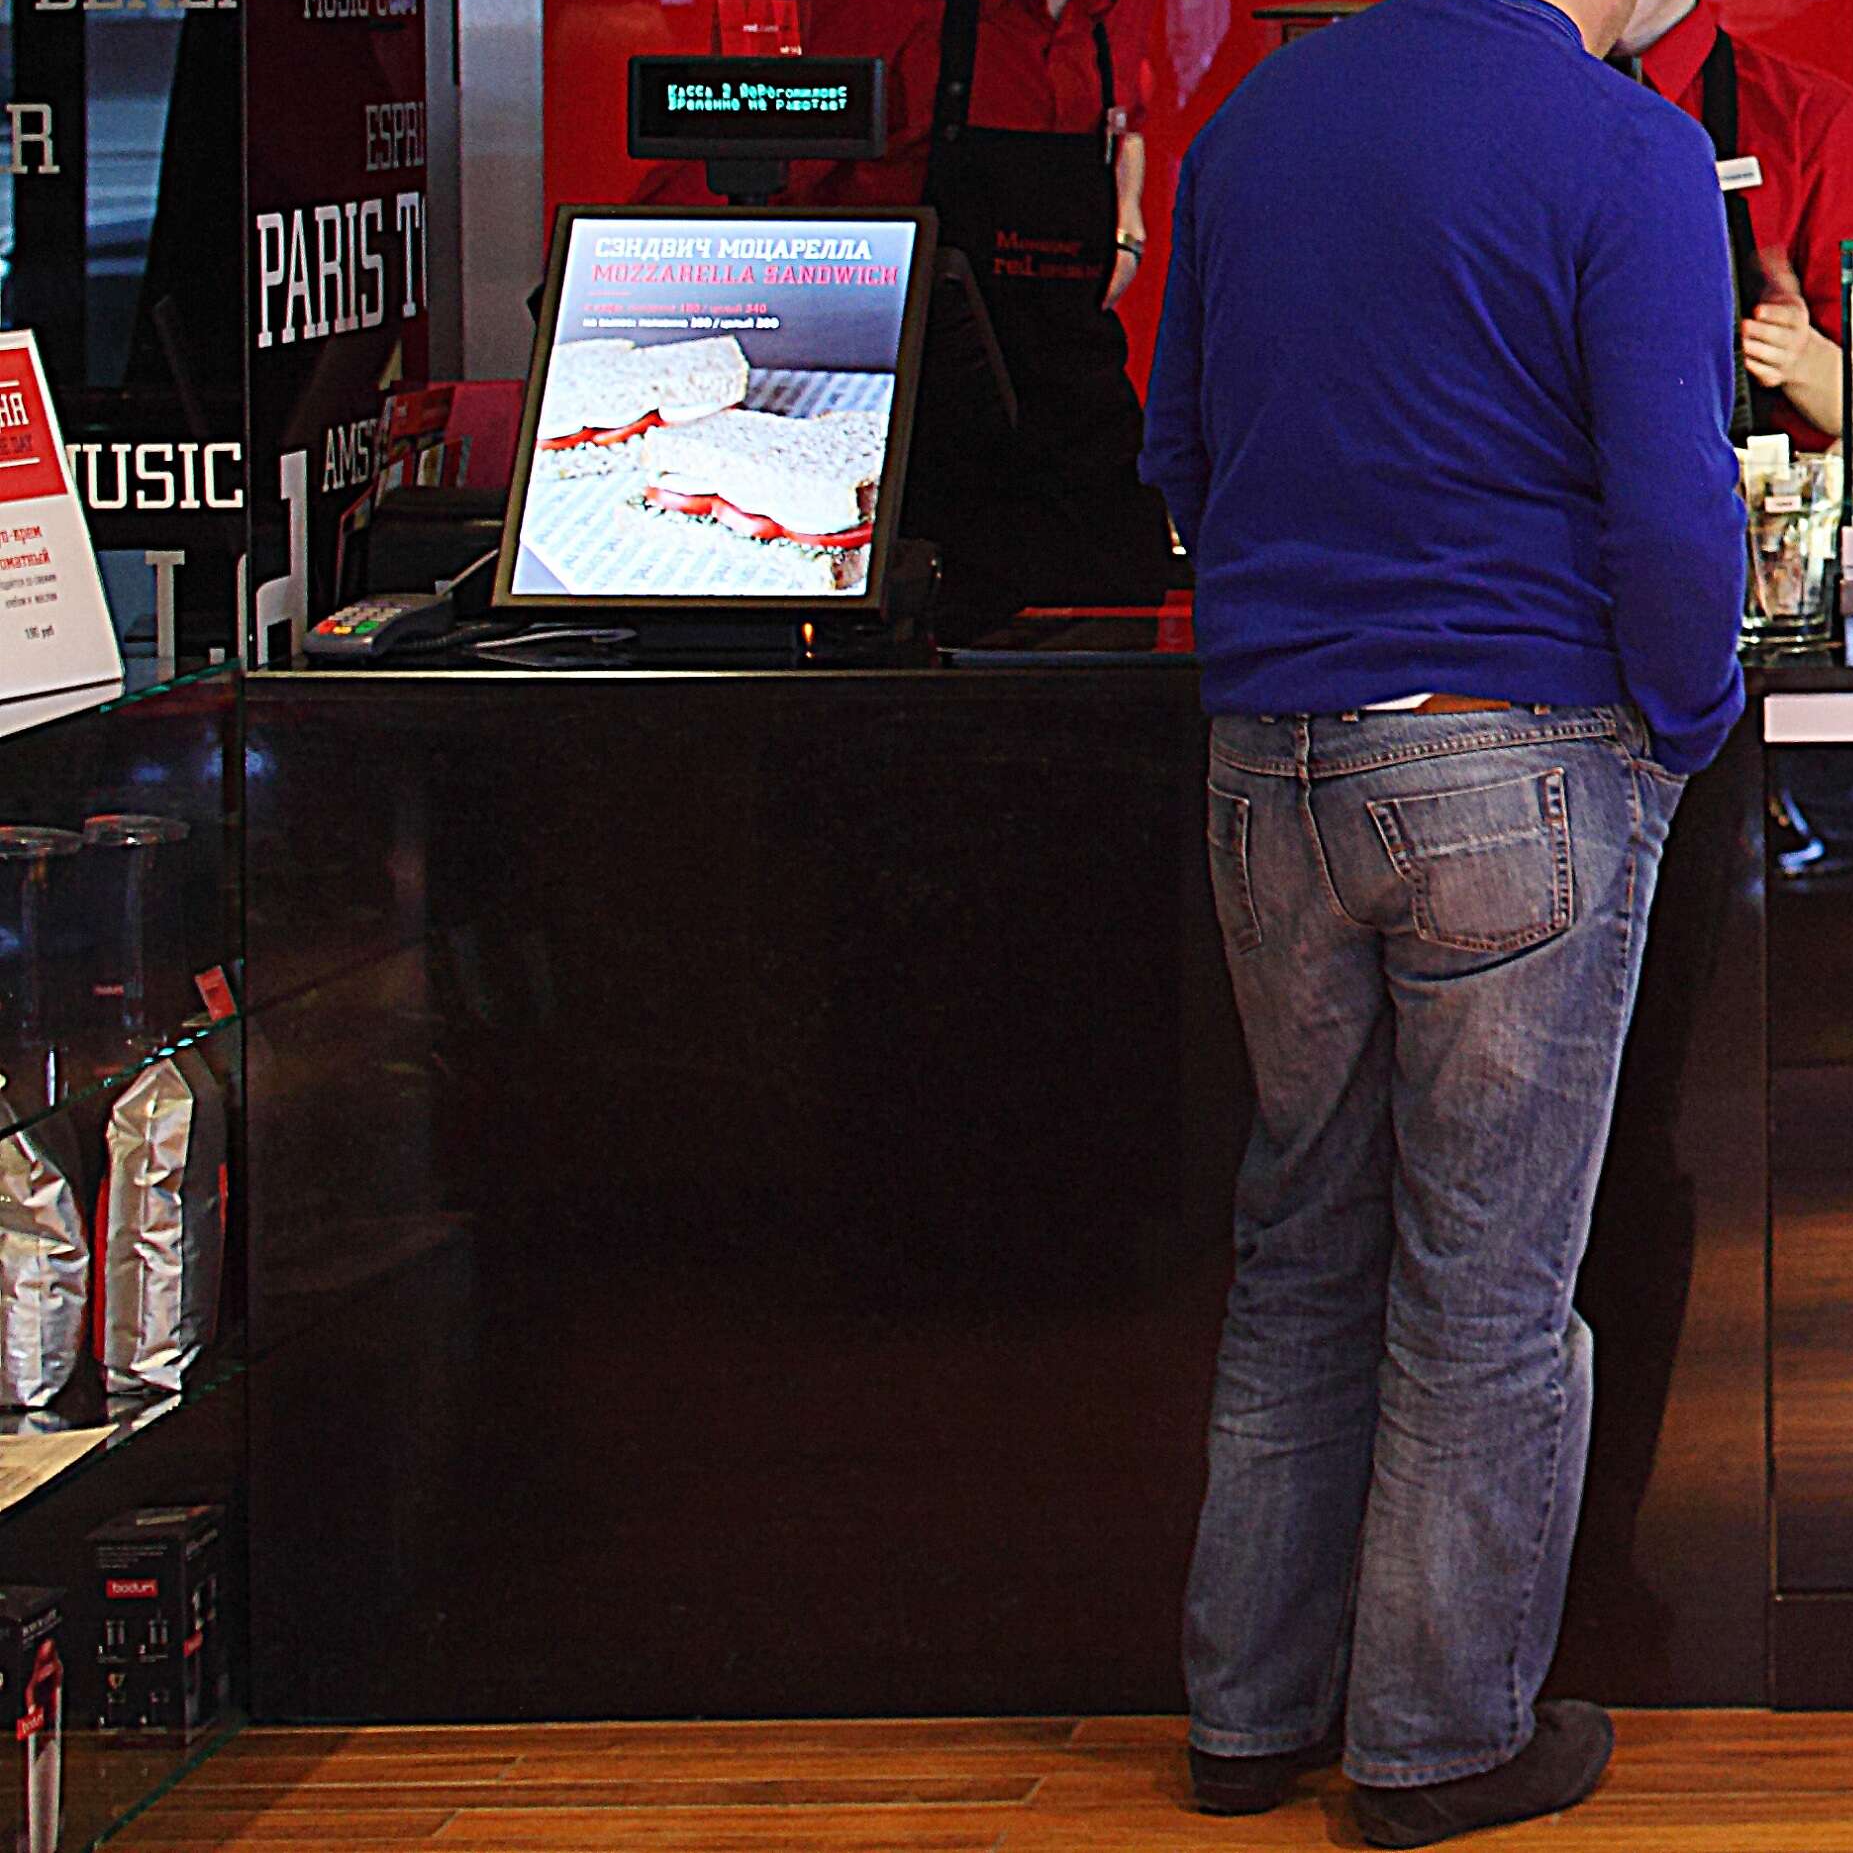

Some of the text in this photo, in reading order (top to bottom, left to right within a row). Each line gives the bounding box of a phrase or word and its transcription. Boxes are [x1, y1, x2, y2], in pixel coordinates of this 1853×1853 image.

[594, 237, 872, 261] СЭНДВИЧ МОЦАРЕЛЛА
[256, 198, 385, 348] PARIS
[592, 264, 897, 285] MOZZARELLA SANDWICH
[0, 548, 51, 570] оматный
